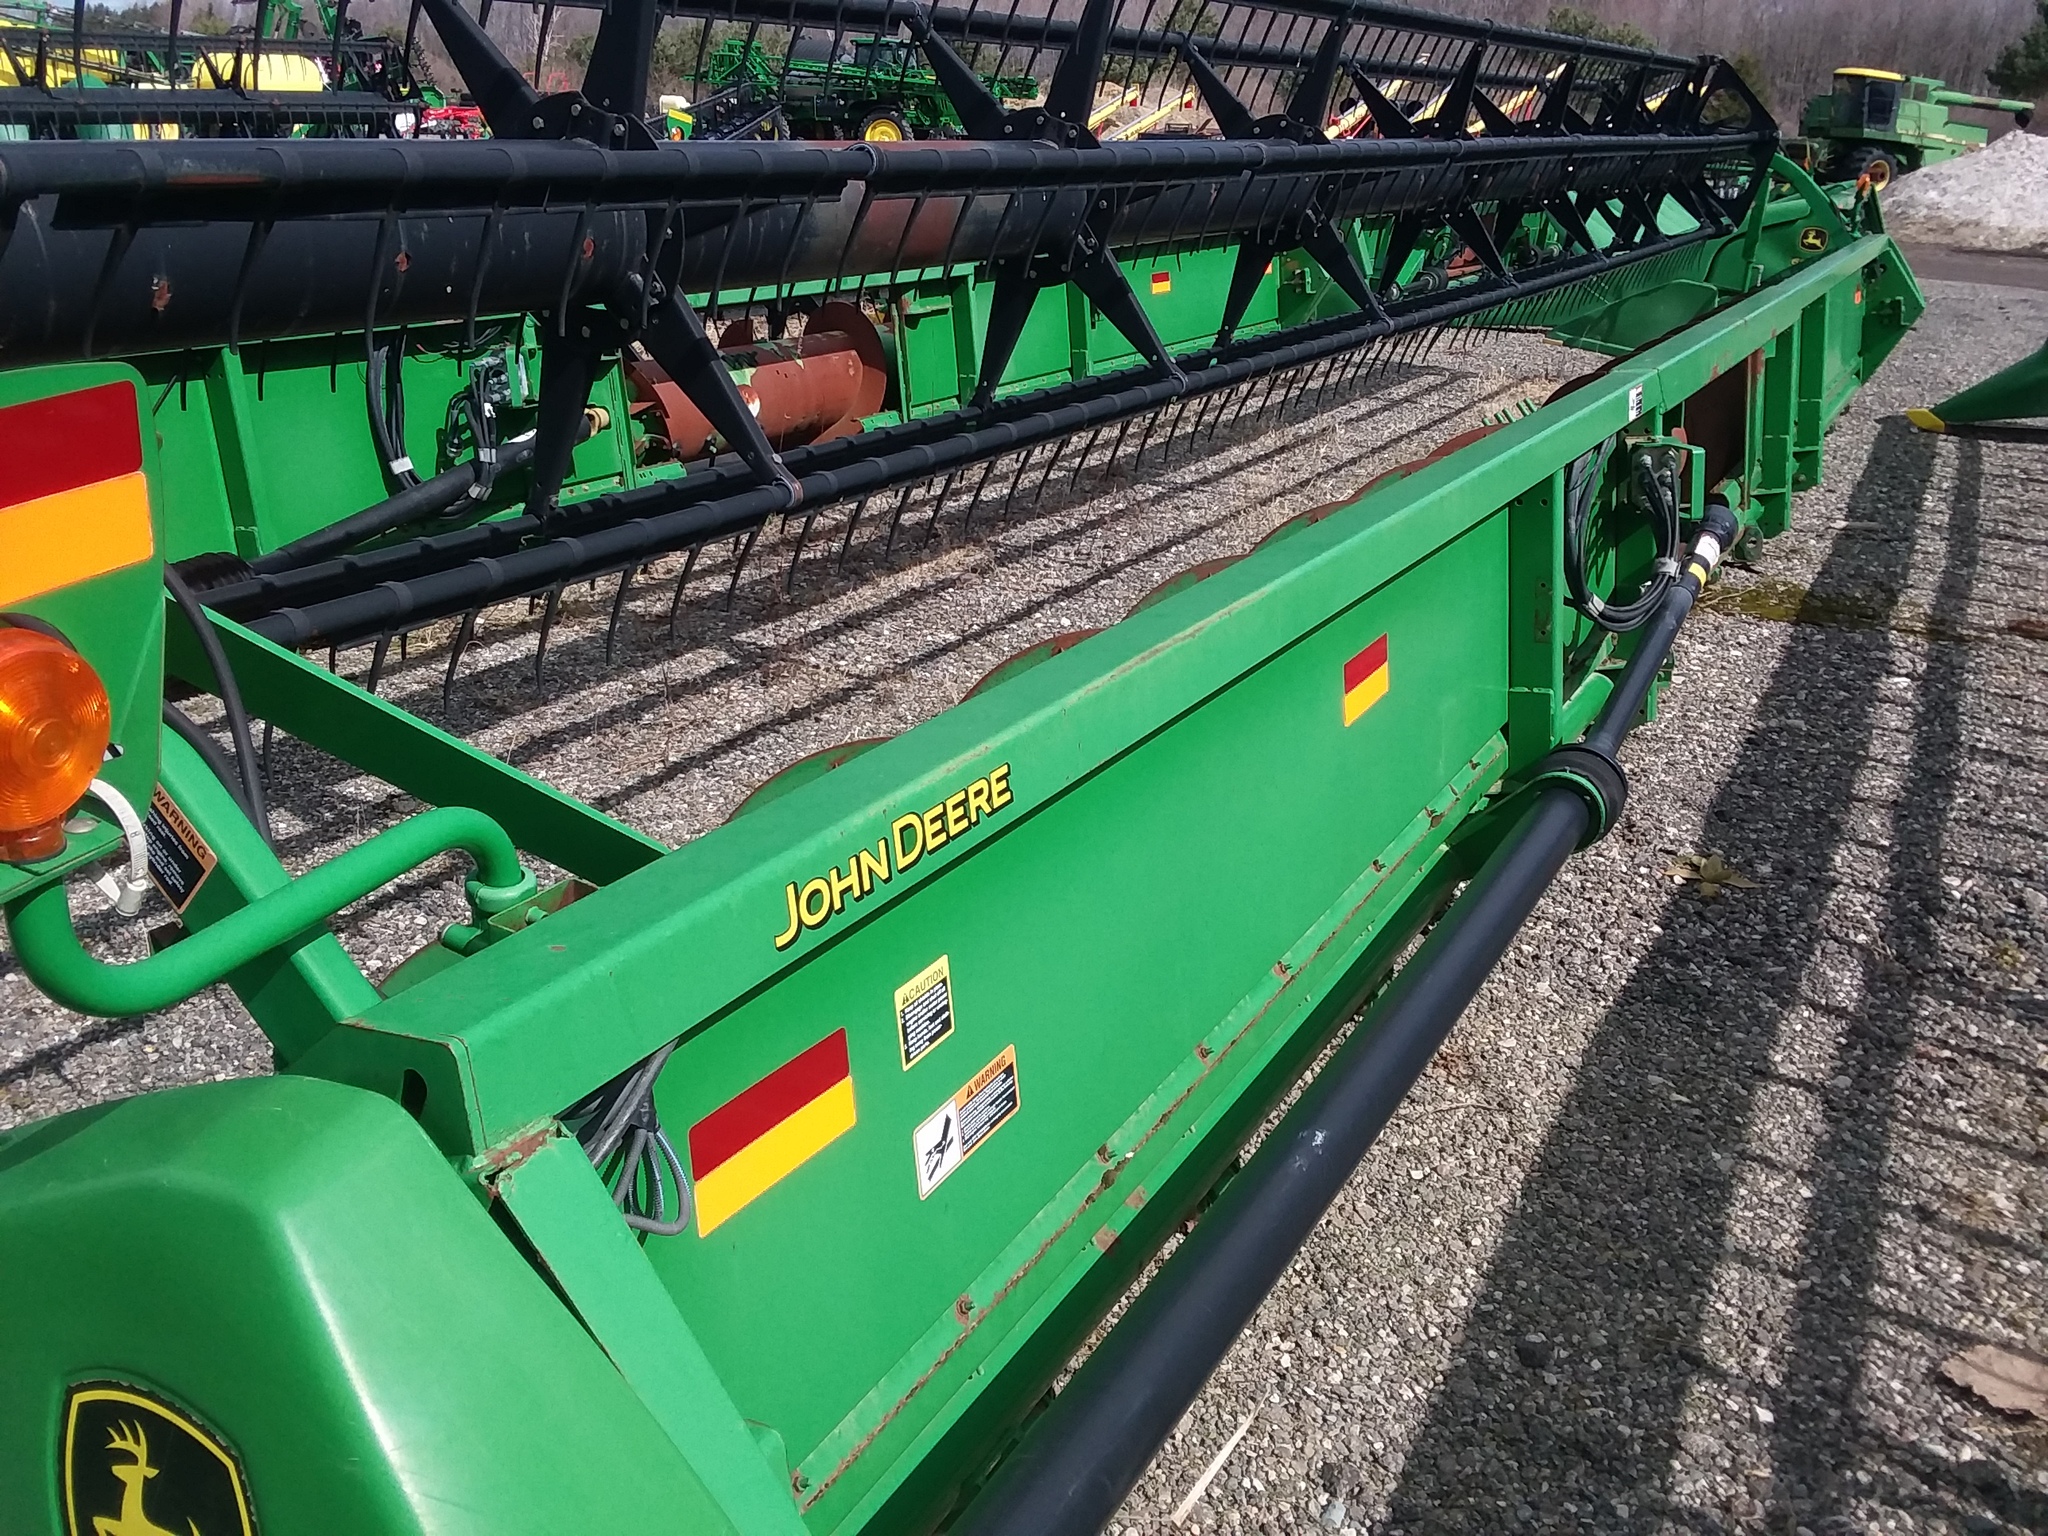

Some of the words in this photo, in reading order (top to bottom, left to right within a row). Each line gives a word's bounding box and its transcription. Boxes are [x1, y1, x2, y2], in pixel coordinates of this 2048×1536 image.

[153, 787, 207, 860] WARNING
[168, 855, 180, 873] under
[177, 844, 188, 859] from
[774, 837, 893, 952] JOHN
[891, 762, 1014, 872] DEERE
[909, 966, 944, 999] CAUTION
[973, 1055, 1007, 1092] WARNING
